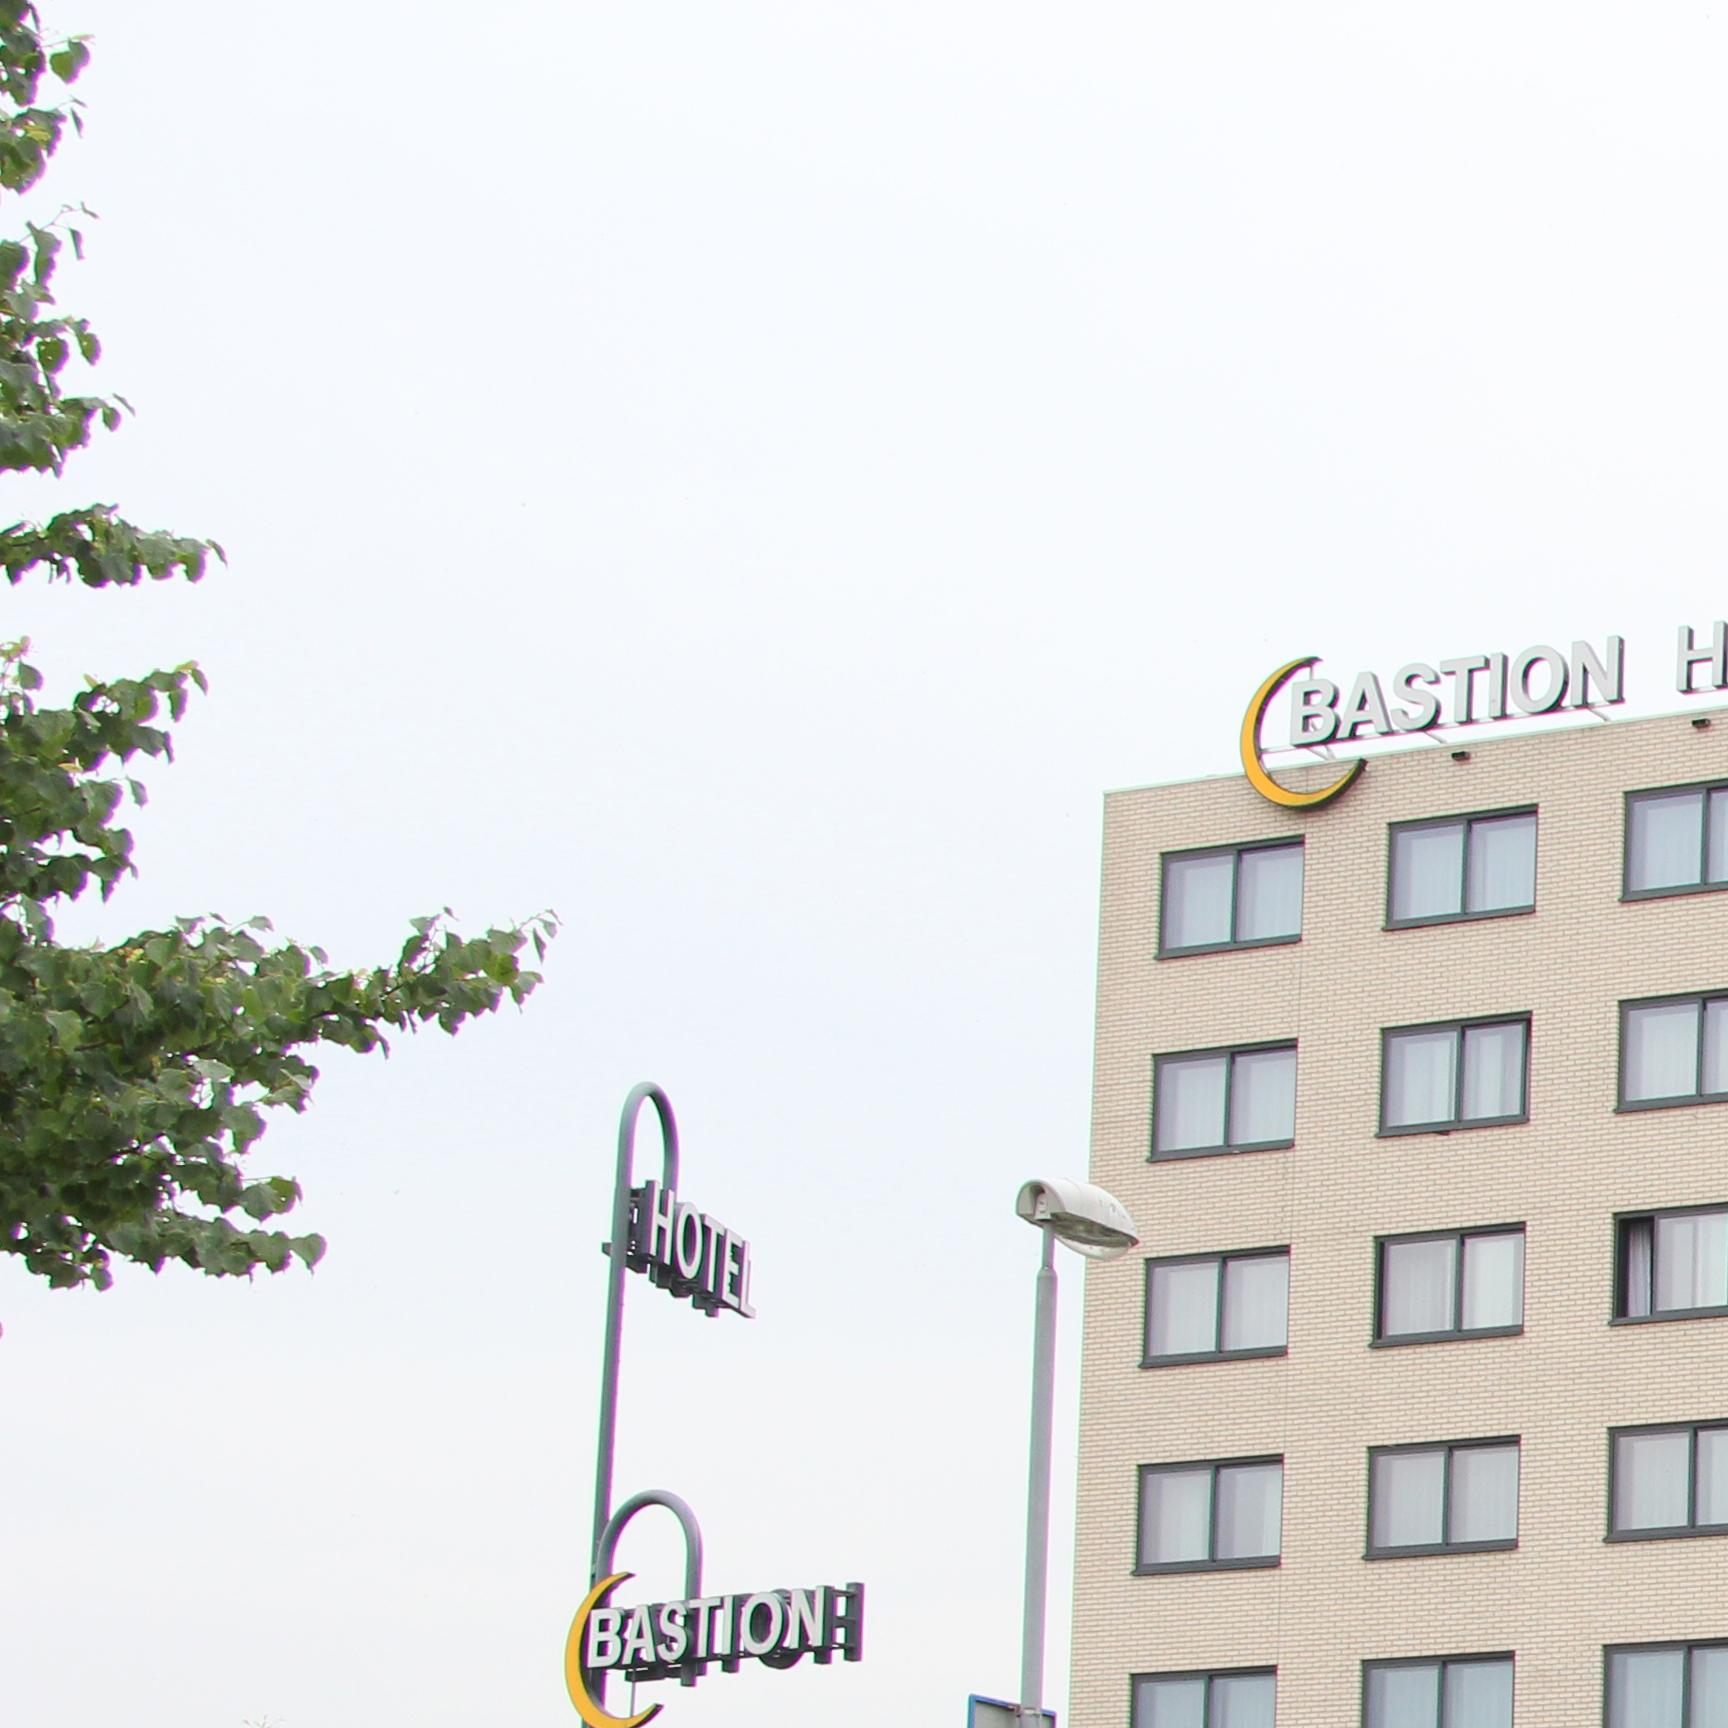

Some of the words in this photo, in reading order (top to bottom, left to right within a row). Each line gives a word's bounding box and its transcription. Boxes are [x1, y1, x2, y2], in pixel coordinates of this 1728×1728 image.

[1289, 635, 1626, 747] BASTION
[646, 1179, 757, 1319] HOTEL
[586, 1585, 834, 1669] BASTION
